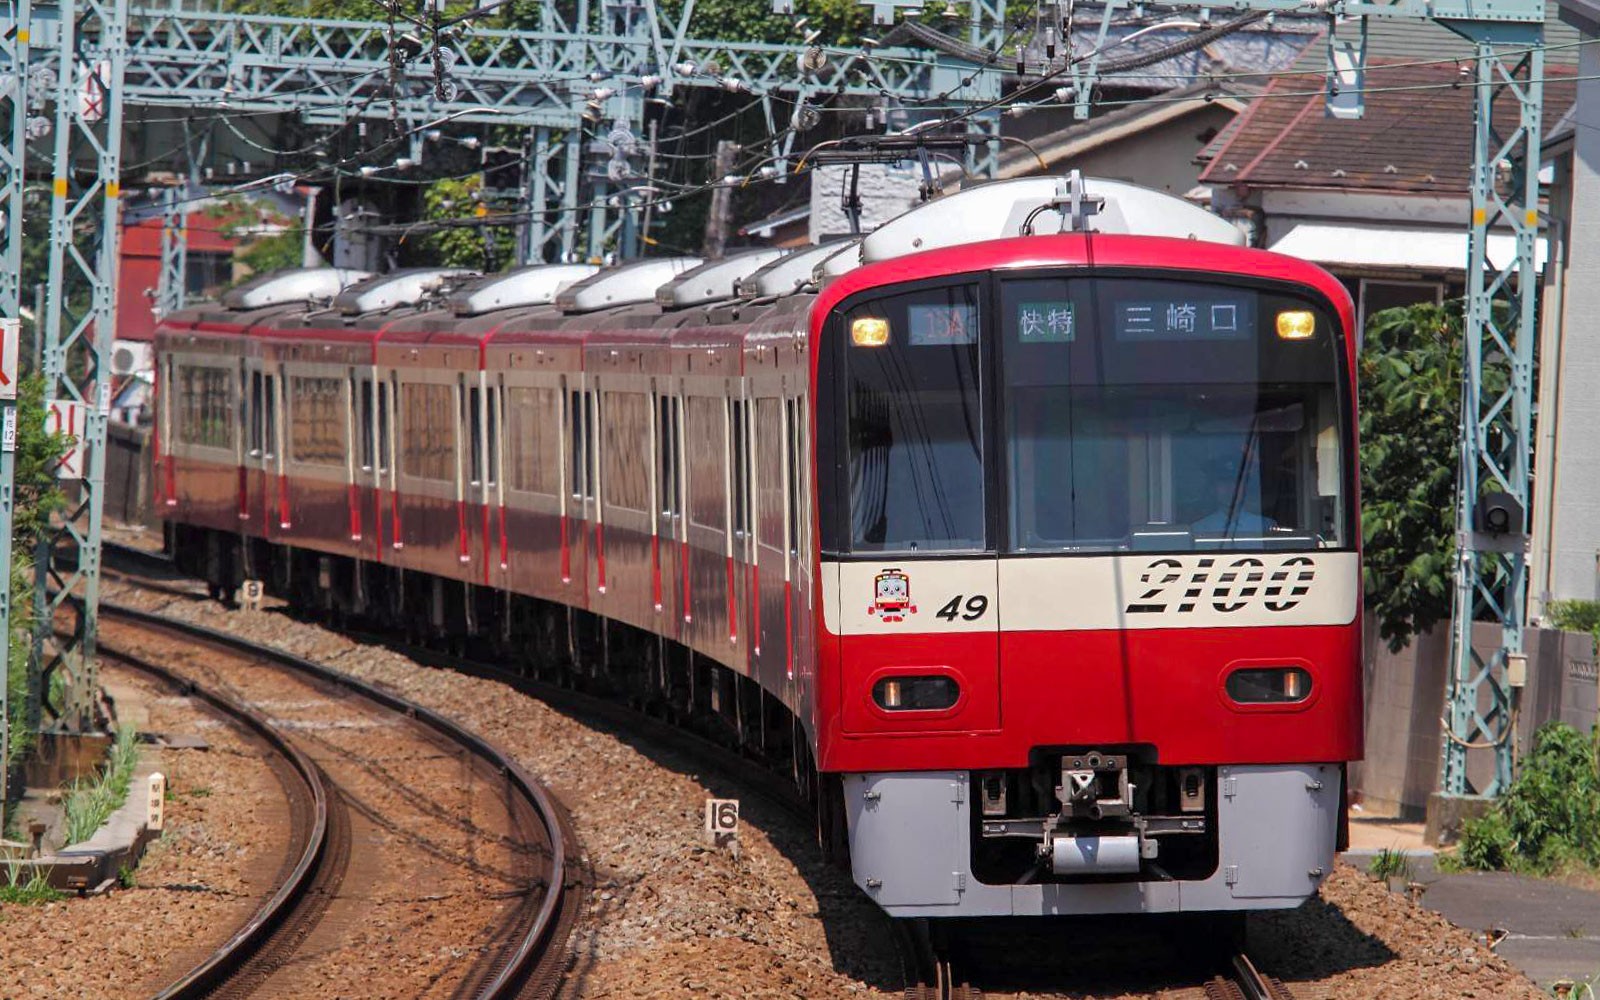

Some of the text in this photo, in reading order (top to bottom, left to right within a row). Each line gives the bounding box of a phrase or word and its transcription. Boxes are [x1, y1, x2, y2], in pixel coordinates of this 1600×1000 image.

[1020, 308, 1073, 336] 快特
[1124, 303, 1237, 333] 三崎口
[1125, 557, 1315, 614] 2100
[935, 595, 989, 622] 49
[711, 802, 738, 829] 16
